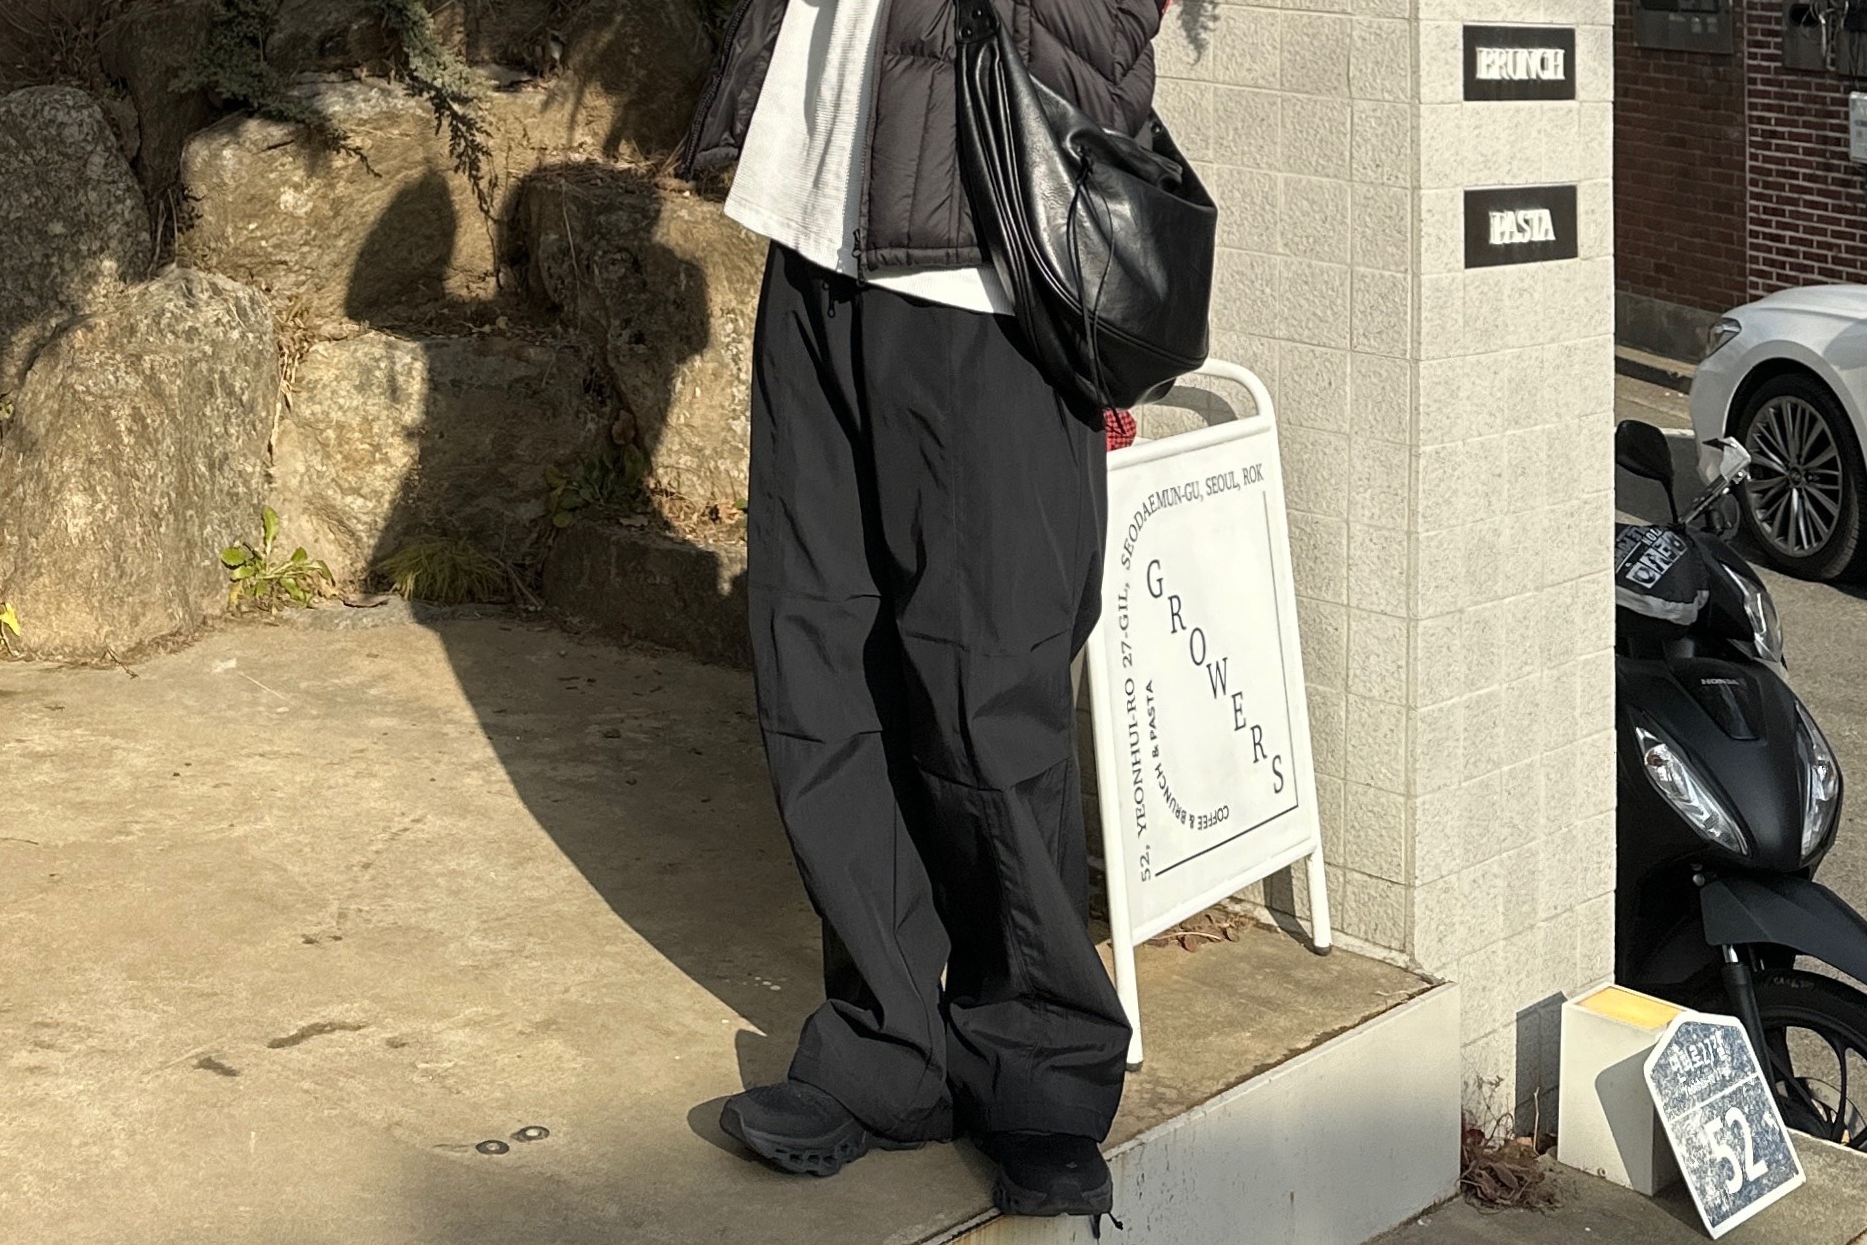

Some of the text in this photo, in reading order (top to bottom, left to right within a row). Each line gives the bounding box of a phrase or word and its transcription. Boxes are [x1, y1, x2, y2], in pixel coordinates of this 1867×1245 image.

[1475, 46, 1565, 81] BRUNCH
[1489, 208, 1556, 245] PASTA
[1118, 463, 1264, 882] 52, YEONHUI-RO 27-GIL, SEODAEMUN-GU, SEOUL, ROK
[1147, 559, 1284, 794] GROWERS
[1145, 679, 1229, 830] COFFEE & BRUNCH & PASTA
[1704, 1106, 1768, 1194] 52
